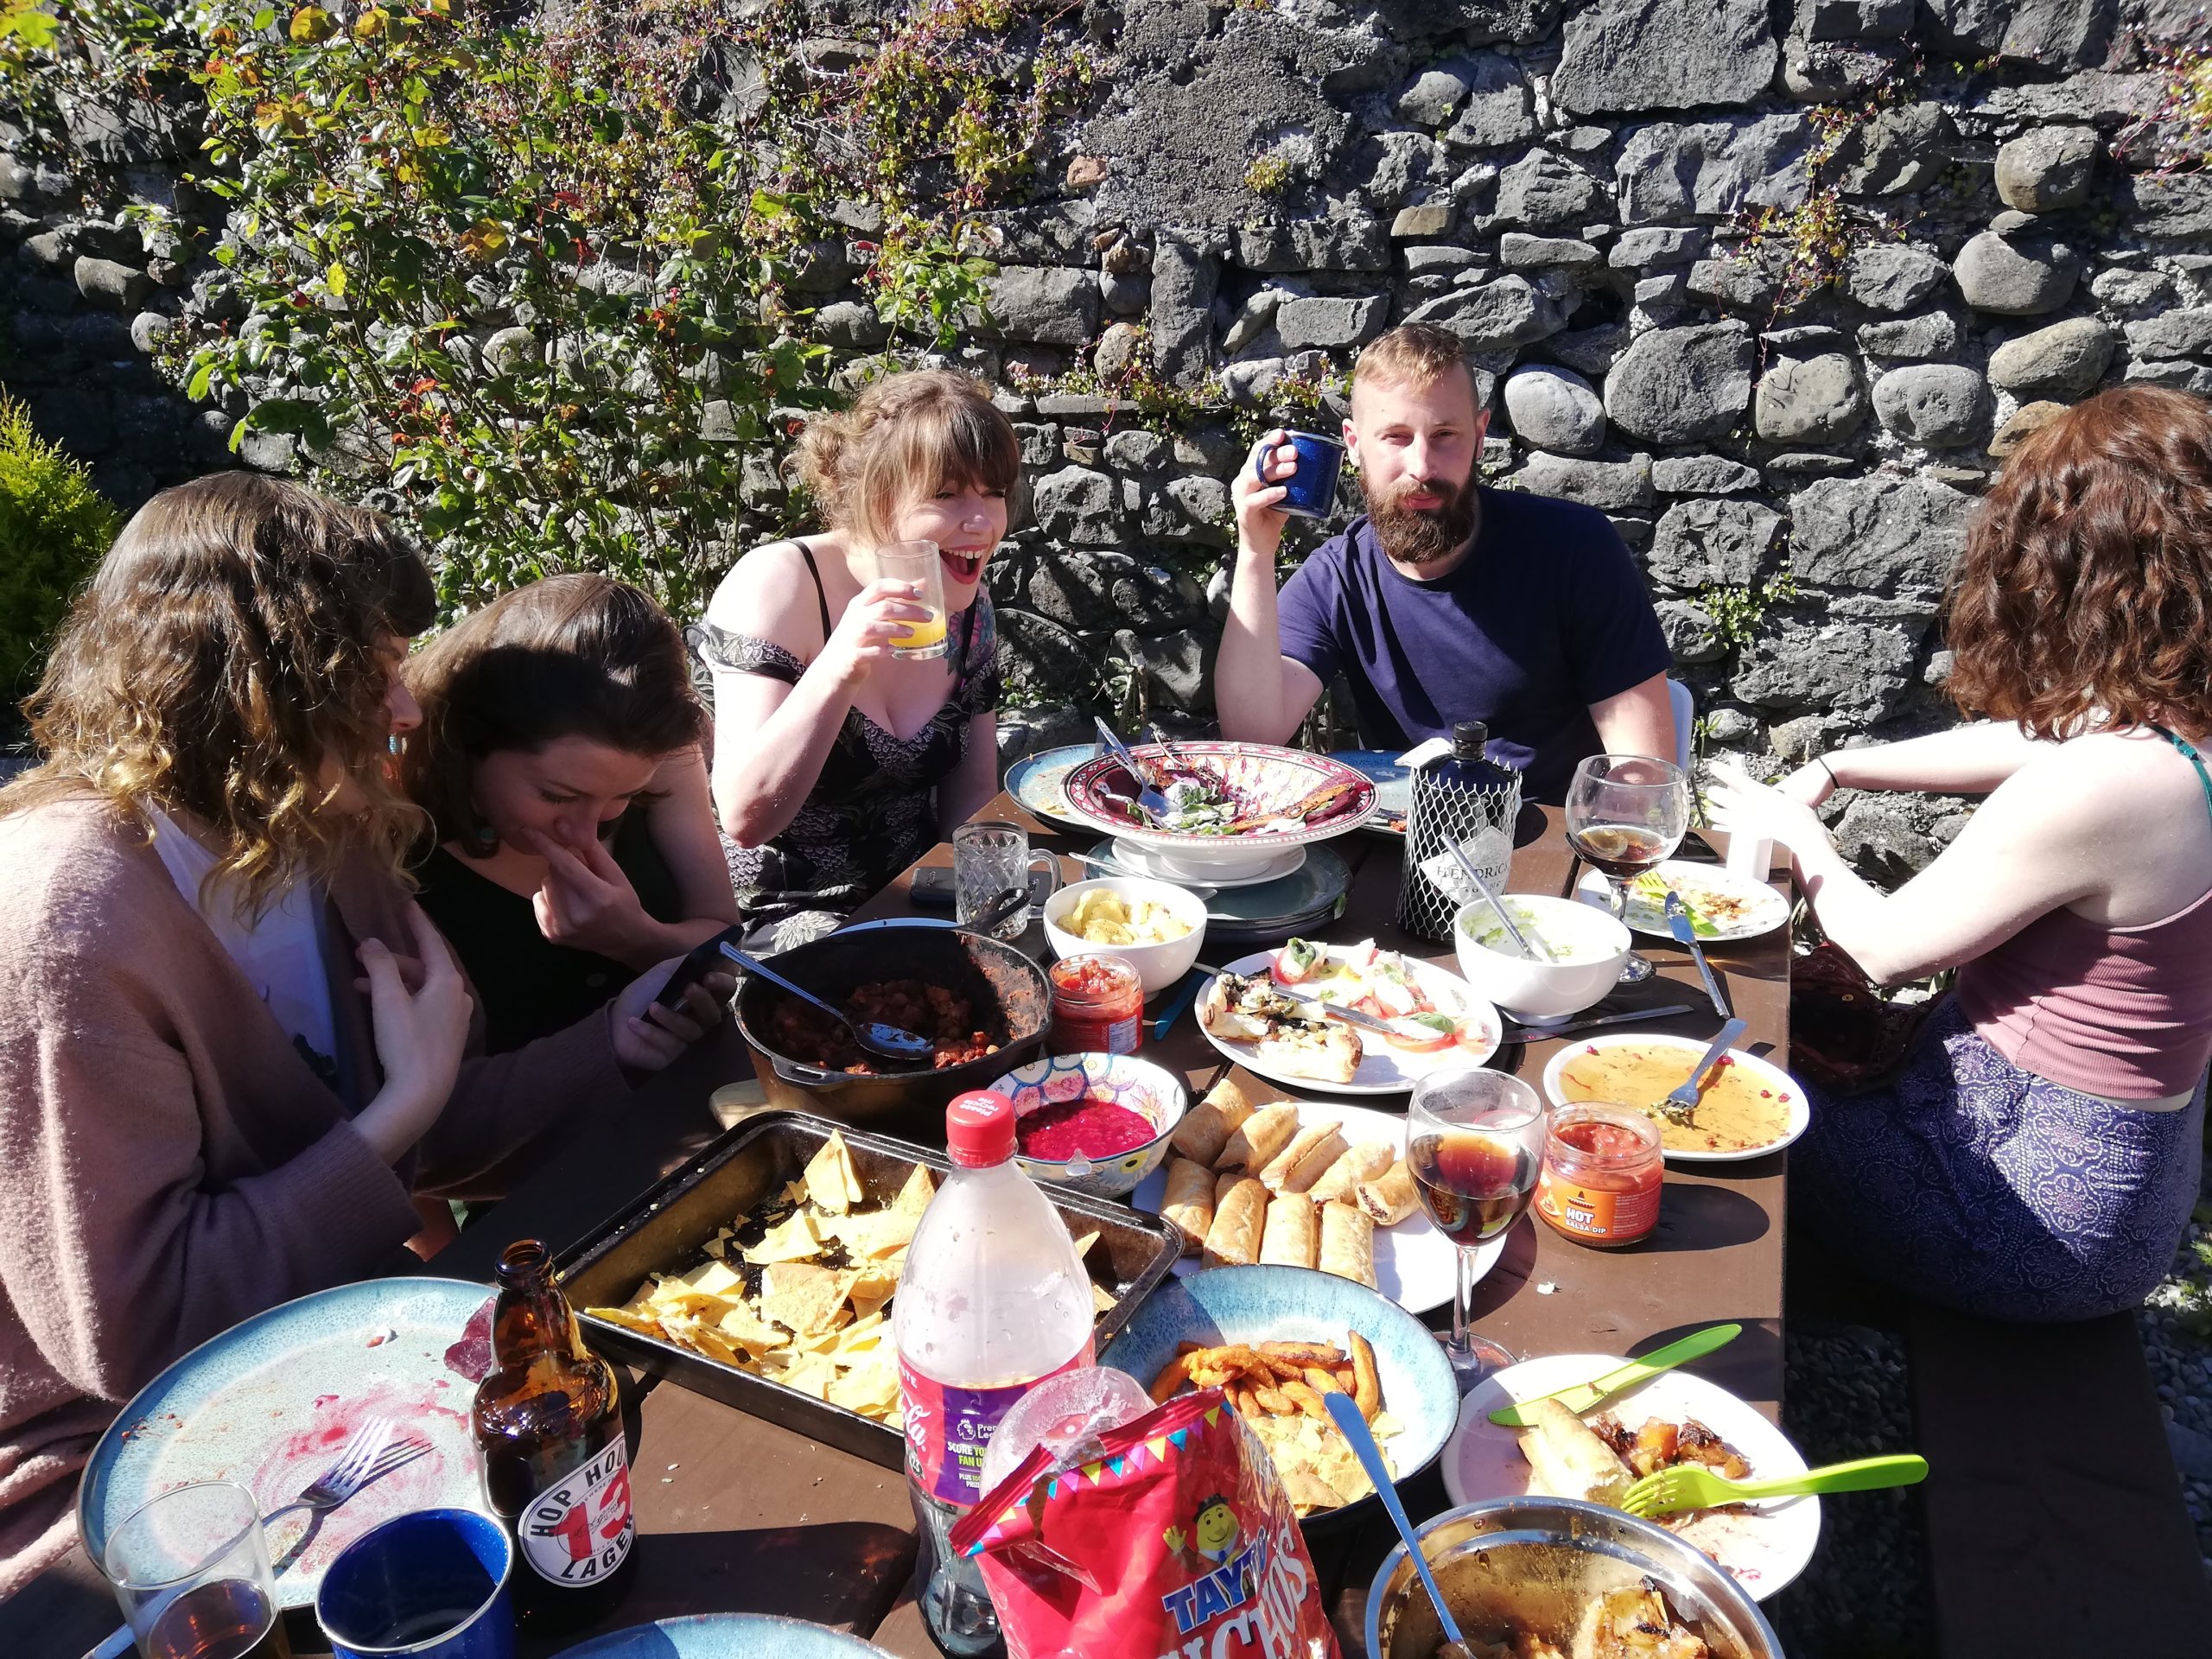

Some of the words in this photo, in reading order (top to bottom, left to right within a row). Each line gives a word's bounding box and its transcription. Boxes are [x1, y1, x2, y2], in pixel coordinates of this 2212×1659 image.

[1436, 862, 1510, 880] HENDRIC
[958, 1103, 993, 1117] Please
[963, 1099, 1000, 1112] recycle
[1566, 1206, 1595, 1224] HOT
[1565, 1219, 1591, 1232] SALSA
[947, 1440, 973, 1456] SCORE
[973, 1446, 988, 1457] YO
[958, 1454, 976, 1467] FAN
[530, 1489, 572, 1538] HOP
[584, 1441, 627, 1487] HOU
[552, 1465, 632, 1562] 13
[561, 1513, 633, 1580] LAGER
[1160, 1524, 1268, 1636] TAYTO
